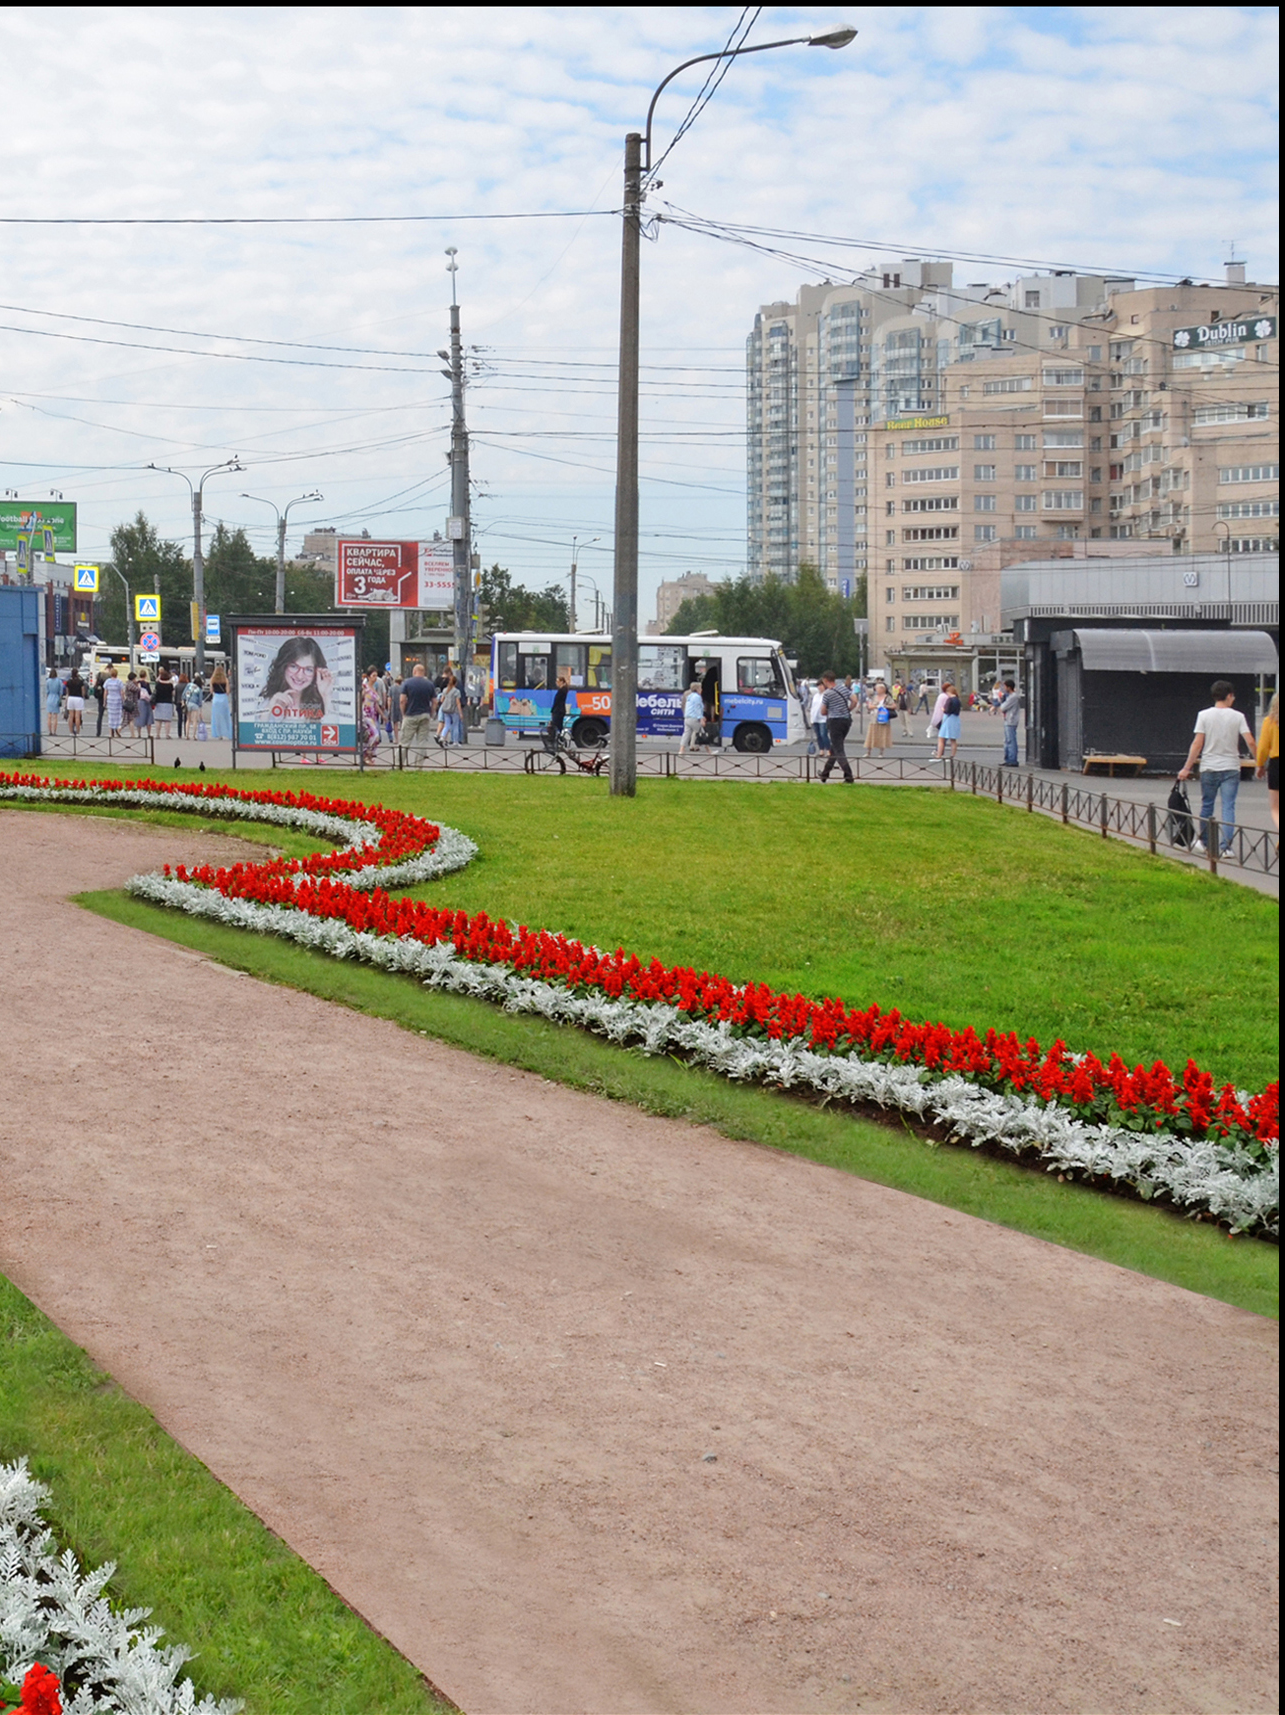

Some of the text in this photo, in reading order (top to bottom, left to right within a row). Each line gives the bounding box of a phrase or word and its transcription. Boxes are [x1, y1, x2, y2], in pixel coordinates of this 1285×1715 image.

[1197, 323, 1247, 342] Dublin
[1204, 339, 1224, 347] IRISH
[914, 416, 948, 428] House
[346, 548, 397, 558] КВАРТИРА
[346, 557, 385, 568] СЕЙЧАС,
[373, 568, 396, 576] ЧЕРЕЗ
[354, 576, 386, 594] 3 ГОДА
[592, 695, 611, 711] 50
[723, 697, 764, 706] mebelcity.ru
